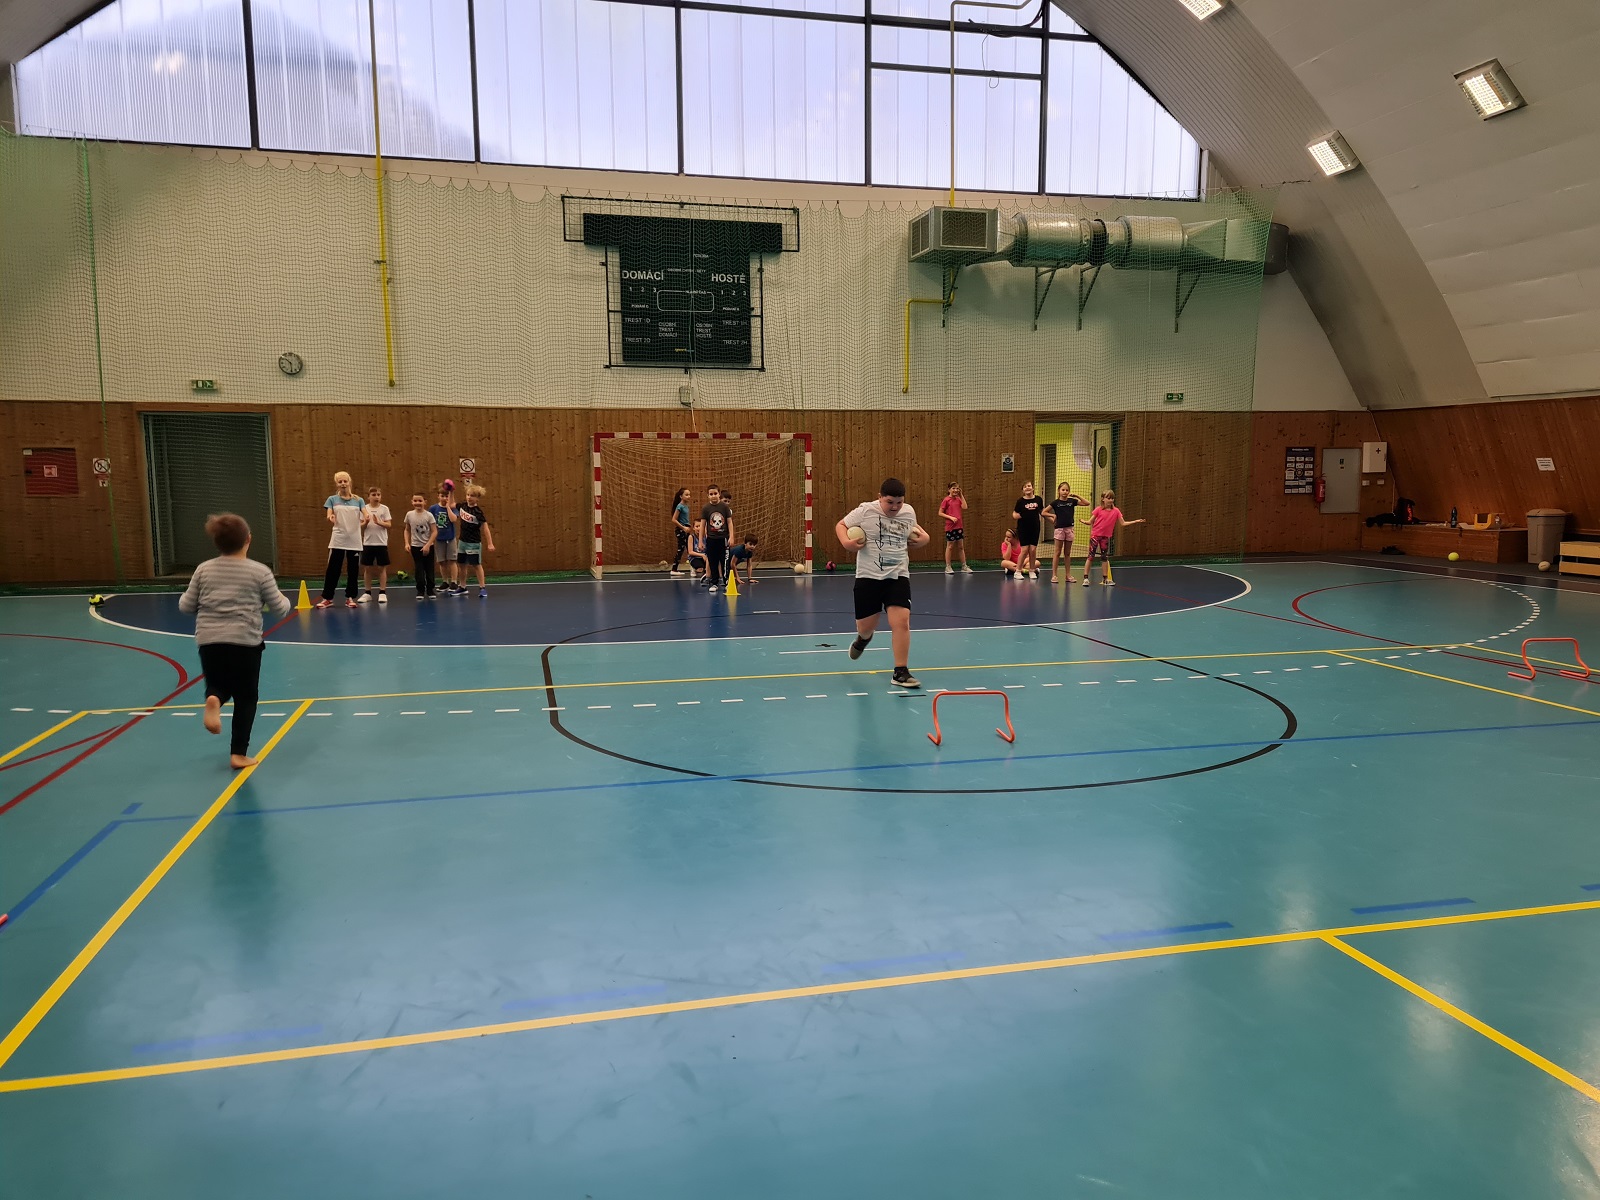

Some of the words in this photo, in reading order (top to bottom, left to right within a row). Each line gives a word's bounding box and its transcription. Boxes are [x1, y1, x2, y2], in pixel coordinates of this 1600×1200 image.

[622, 270, 664, 281] DOMÁCÍ
[711, 273, 746, 284] HOSTÉ
[461, 510, 473, 521] NASA
